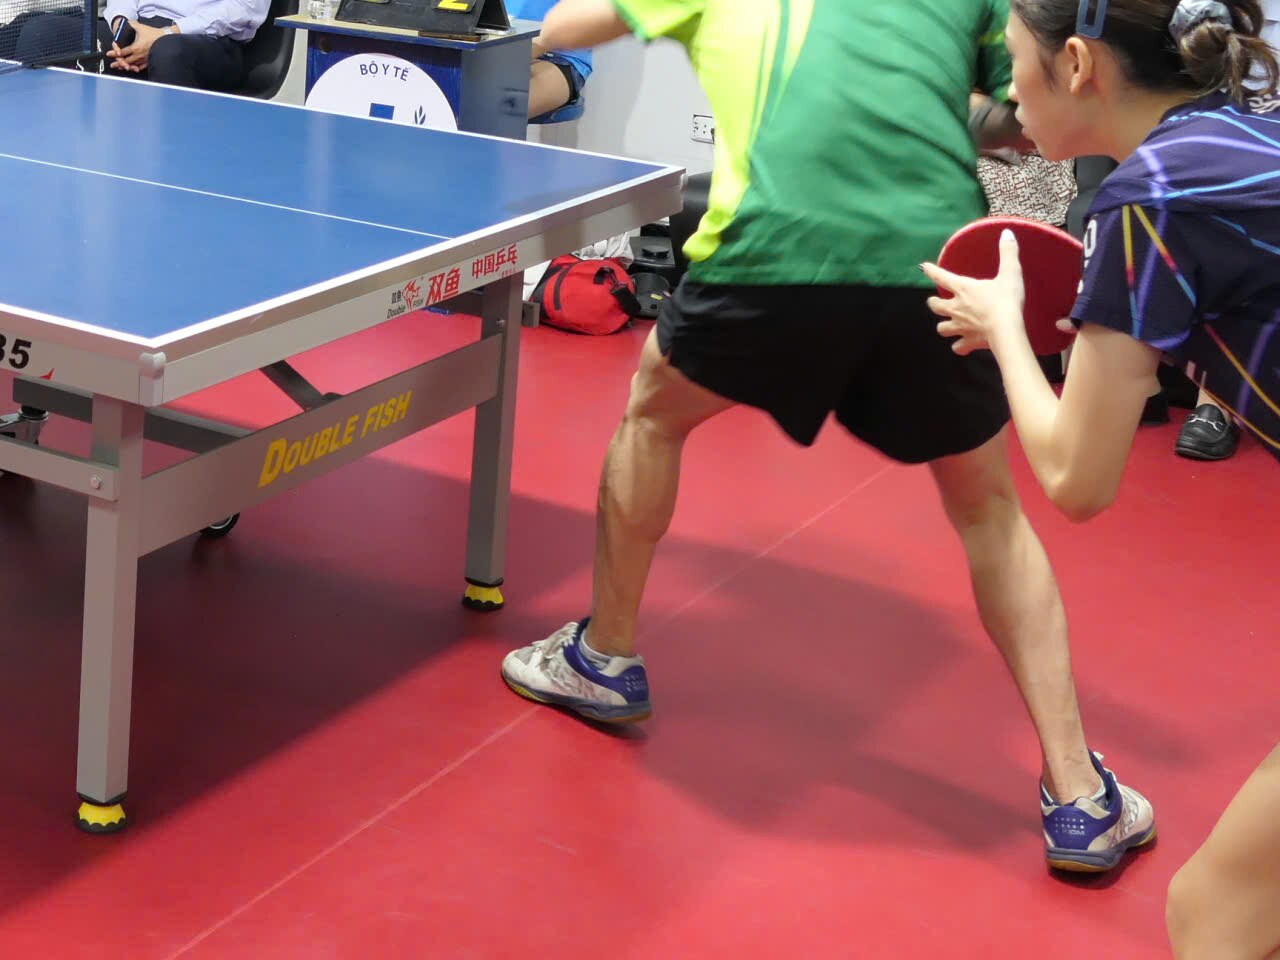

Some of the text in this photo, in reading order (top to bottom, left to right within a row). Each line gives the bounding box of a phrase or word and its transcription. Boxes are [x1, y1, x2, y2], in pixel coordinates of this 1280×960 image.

[359, 60, 411, 82] BỘ Y TẾ
[471, 243, 518, 280] 中国乒乓
[425, 266, 462, 307] 双鱼
[257, 388, 413, 489] DOUBLE FISH
